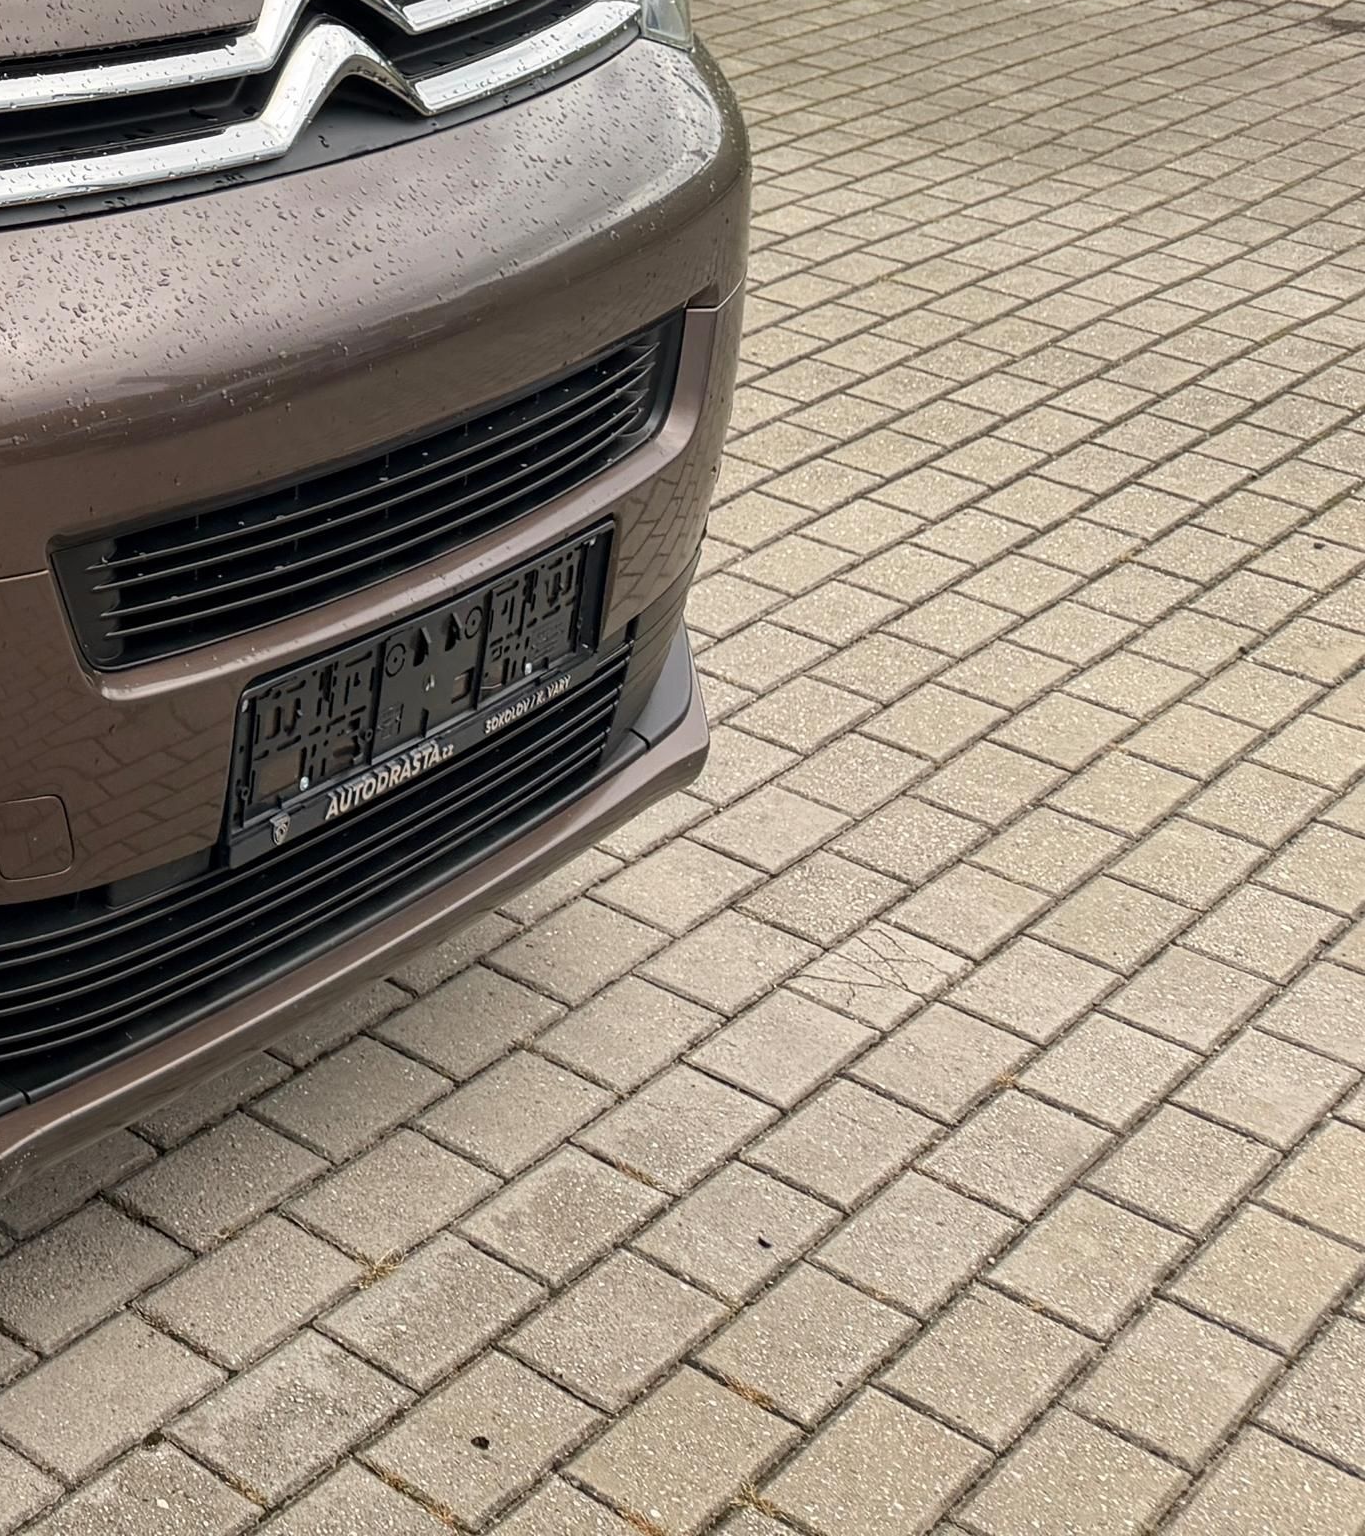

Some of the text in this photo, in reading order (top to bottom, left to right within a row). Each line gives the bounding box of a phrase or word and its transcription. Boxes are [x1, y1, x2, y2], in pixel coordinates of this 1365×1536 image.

[485, 697, 530, 734] SOKOLOV
[547, 674, 571, 699] VARY
[324, 740, 454, 821] AUTODRASTA.cz
